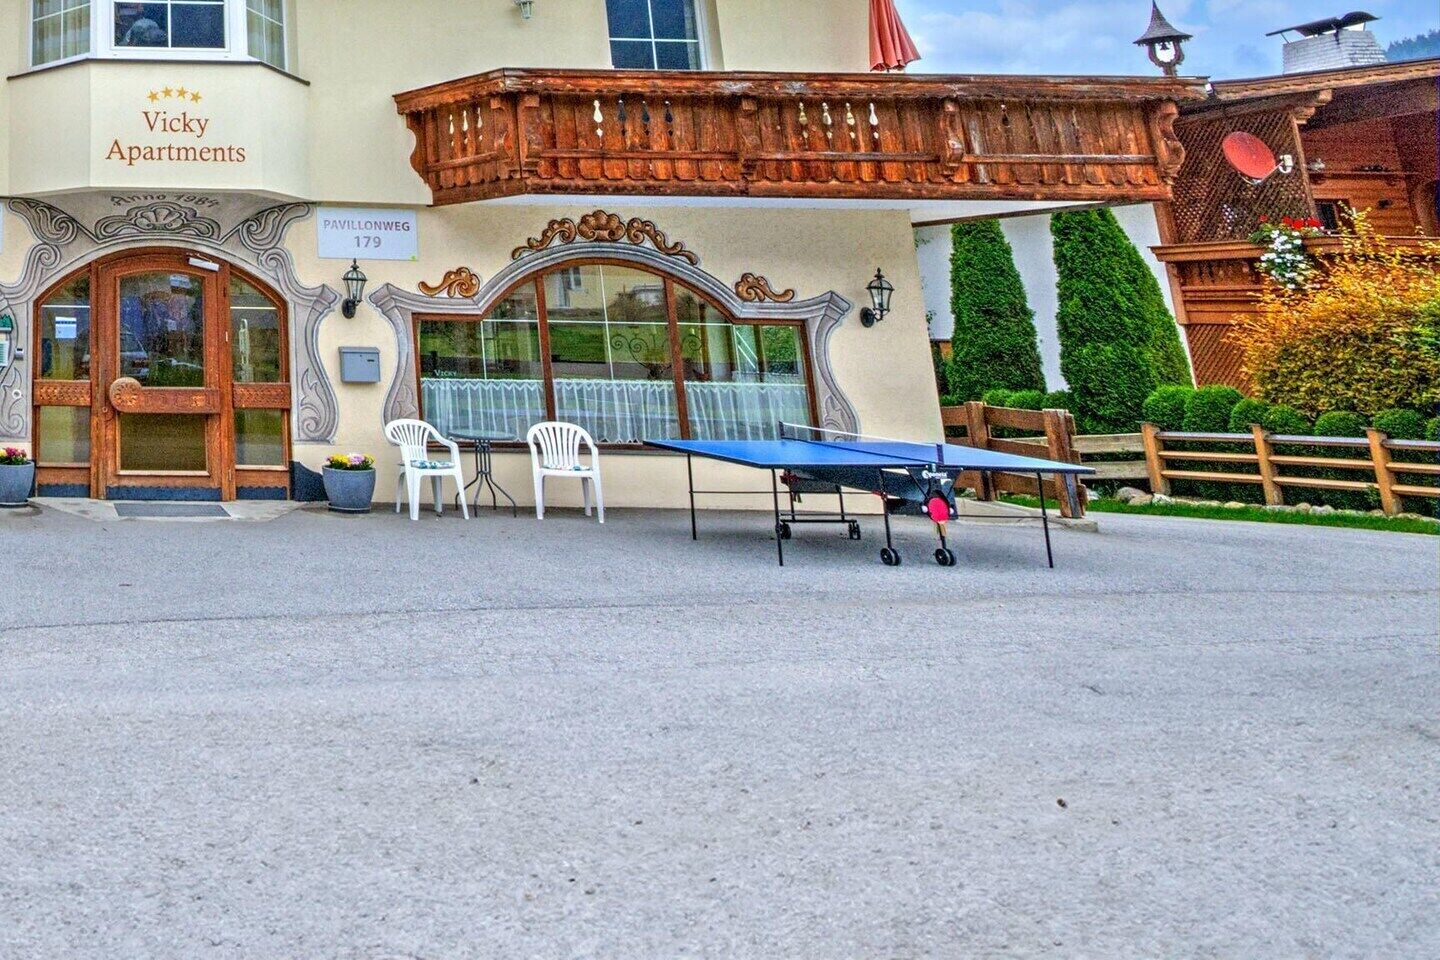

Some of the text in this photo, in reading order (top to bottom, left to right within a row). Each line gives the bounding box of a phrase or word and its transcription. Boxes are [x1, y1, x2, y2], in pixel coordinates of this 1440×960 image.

[142, 111, 209, 138] Vicky
[105, 139, 246, 166] Apartments
[110, 194, 167, 206] Anno
[323, 219, 411, 232] PAVILLONWEG
[354, 236, 382, 248] 179
